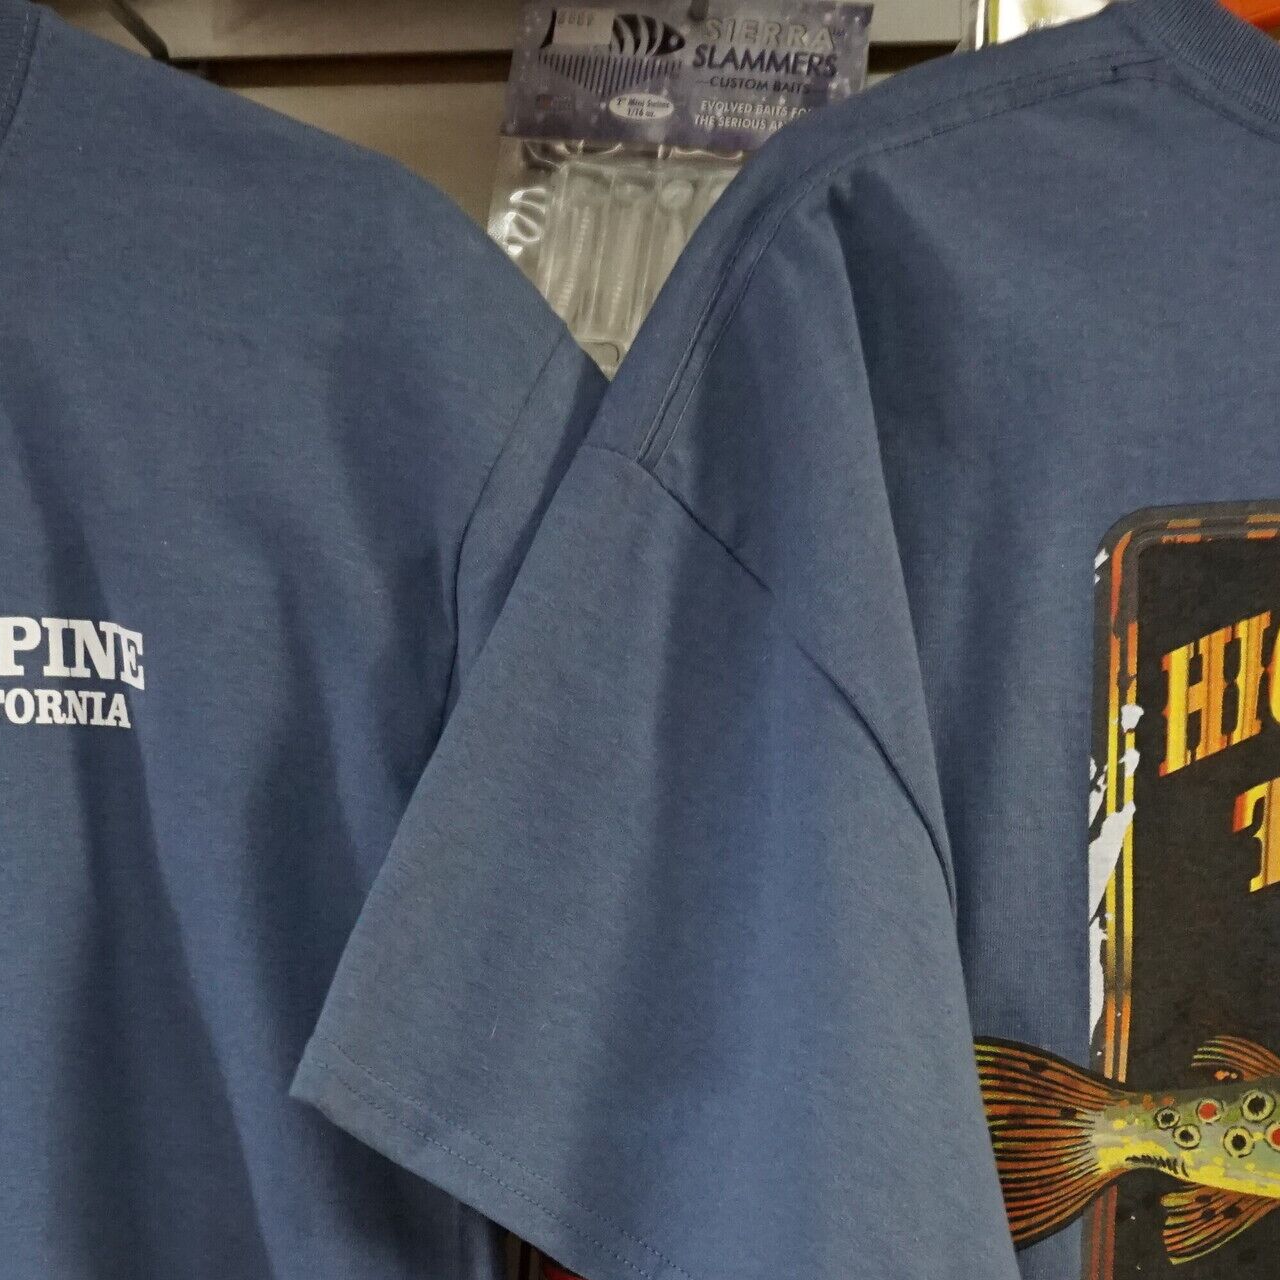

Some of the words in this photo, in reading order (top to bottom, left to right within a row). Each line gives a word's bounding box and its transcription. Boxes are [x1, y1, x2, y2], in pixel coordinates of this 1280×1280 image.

[705, 18, 833, 49] SIERRA
[692, 44, 837, 78] SLAMMERS
[709, 78, 768, 92] CUSTOM
[772, 81, 810, 95] BAITS
[701, 100, 753, 117] EVOLVED
[755, 104, 788, 118] BAITS
[791, 106, 812, 117] FO
[694, 115, 718, 127] THE
[719, 115, 767, 131] SERIOUS
